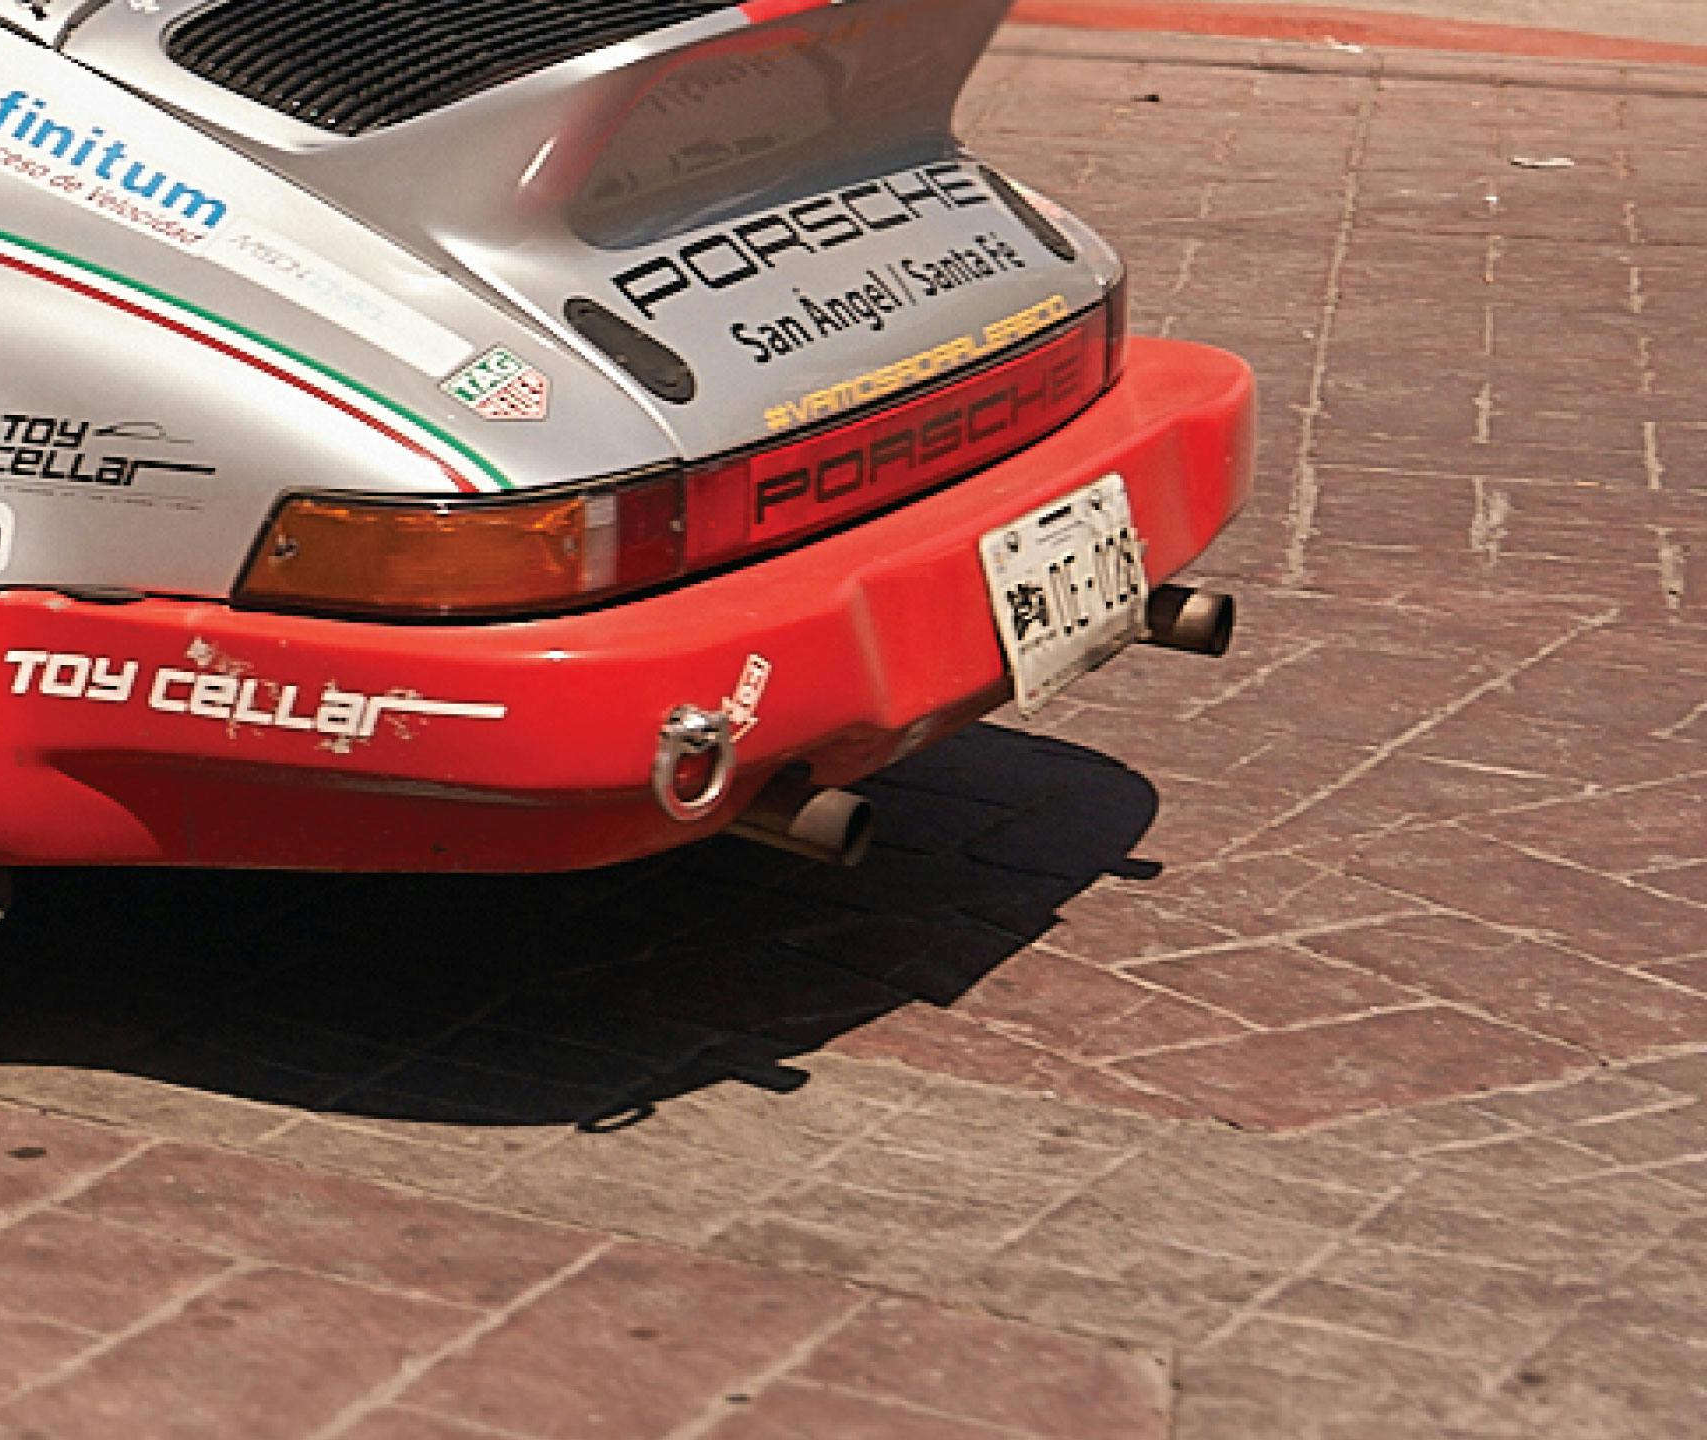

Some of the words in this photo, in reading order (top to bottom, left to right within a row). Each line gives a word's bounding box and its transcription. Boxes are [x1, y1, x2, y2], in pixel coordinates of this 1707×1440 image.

[49, 171, 84, 194] de
[86, 184, 207, 246] Velocidad
[609, 164, 989, 320] PORSCHE
[730, 314, 813, 364] San
[901, 244, 996, 298] Santa
[2, 414, 89, 448] TOY
[755, 352, 1084, 526] PORSCHE
[3, 649, 139, 703] TOY
